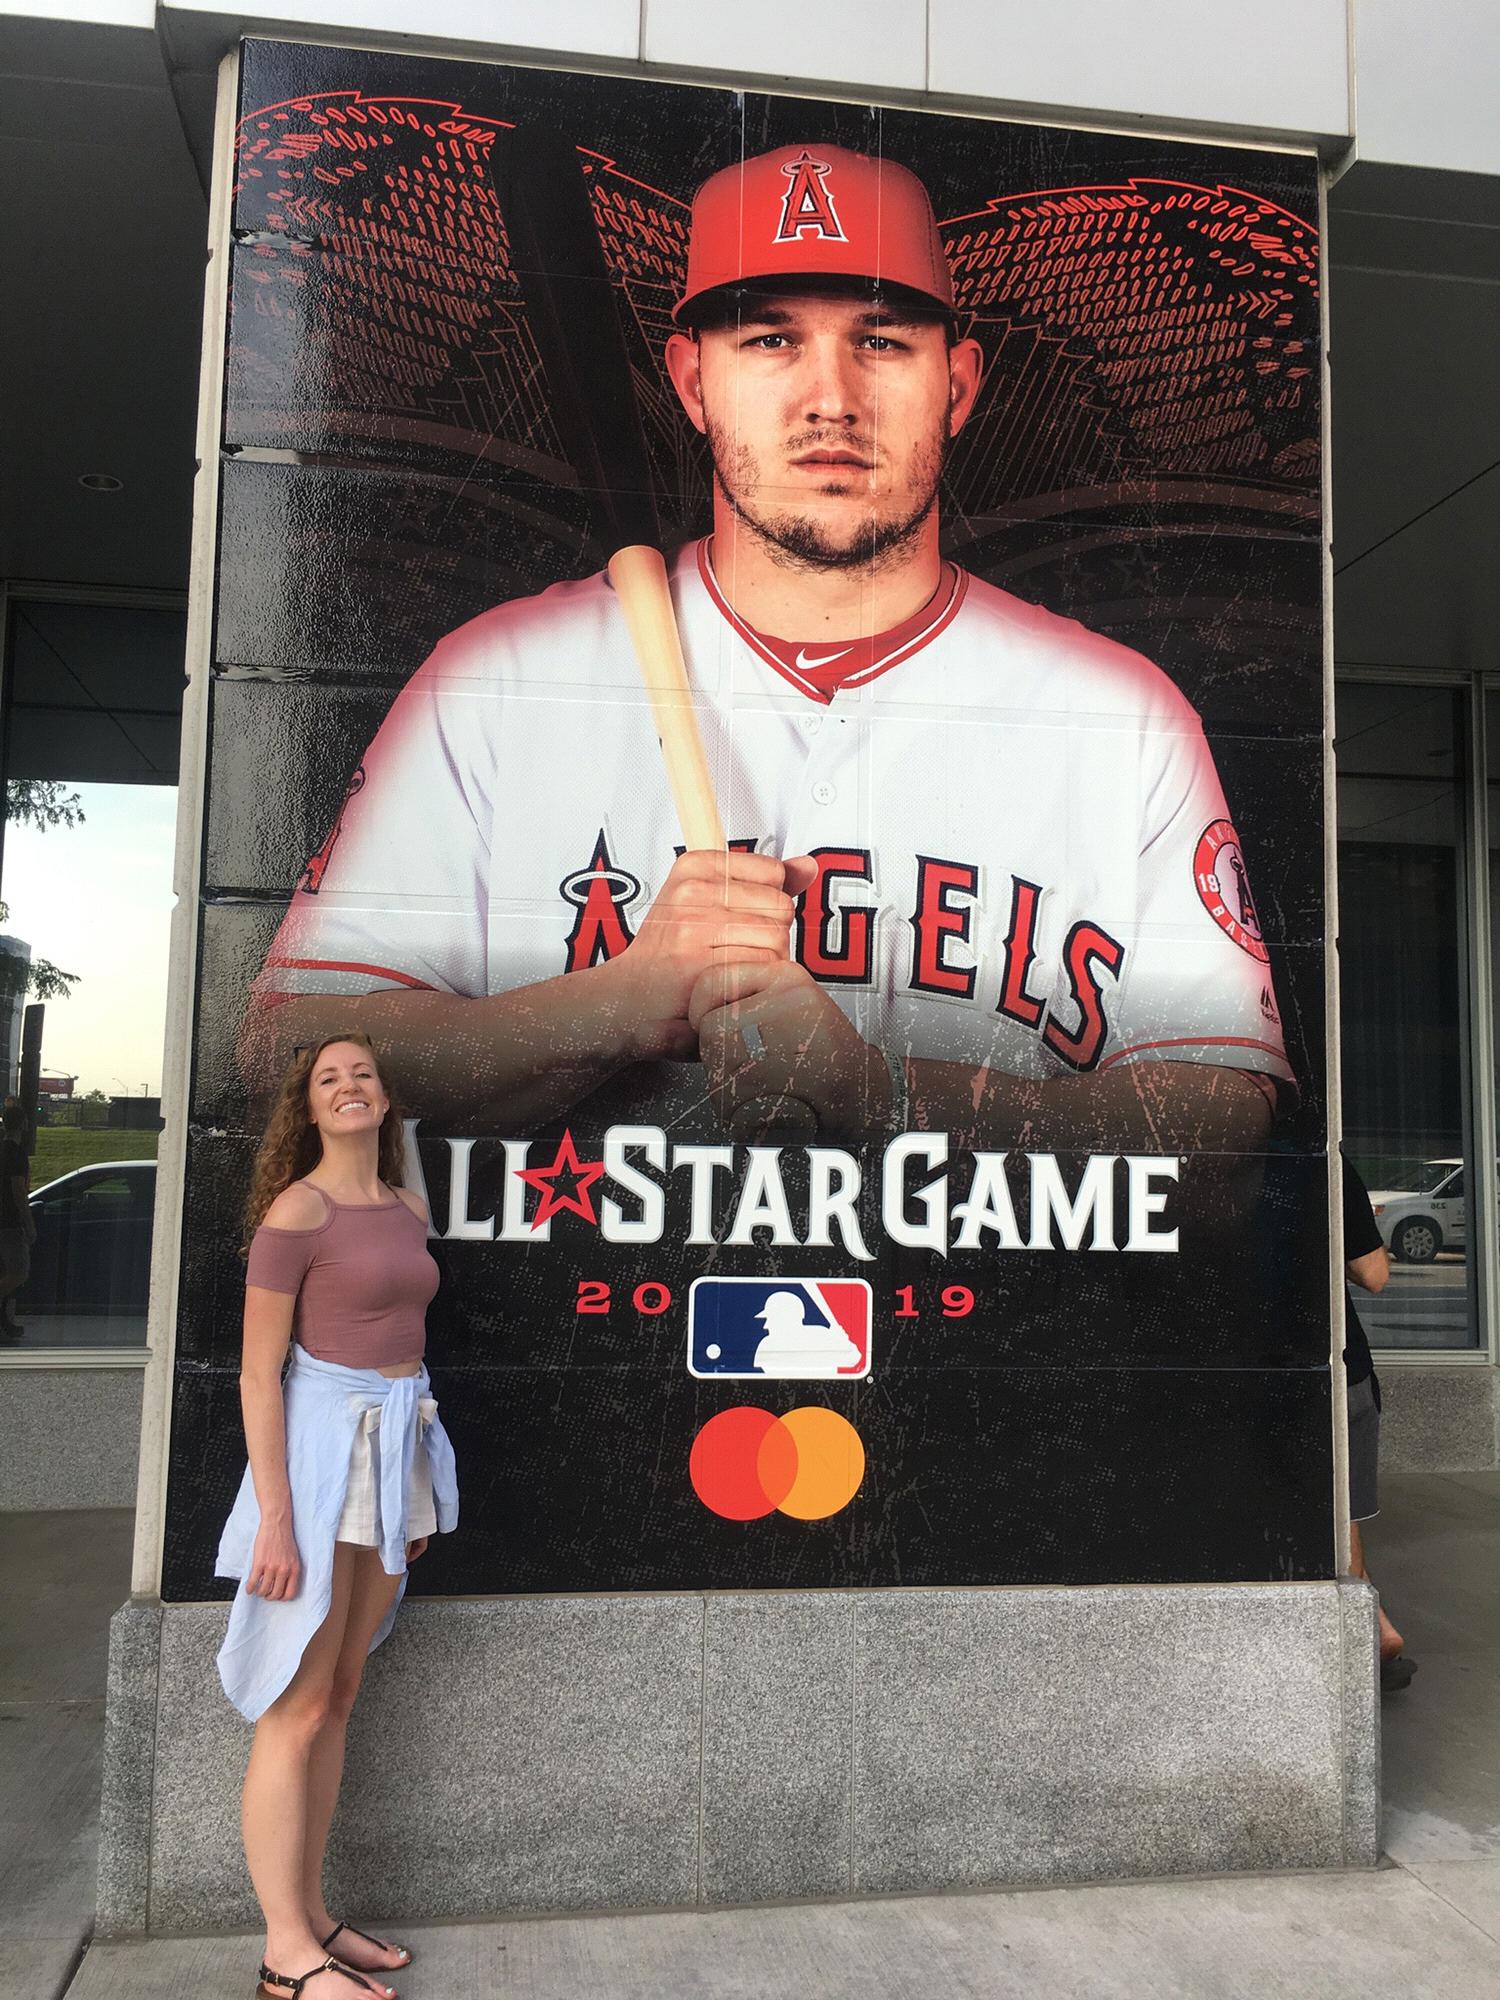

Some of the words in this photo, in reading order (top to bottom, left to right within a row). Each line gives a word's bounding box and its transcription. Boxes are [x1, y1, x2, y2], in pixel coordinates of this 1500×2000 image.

[772, 151, 849, 243] A
[560, 828, 1125, 1073] AGELS
[601, 1124, 876, 1261] STAR
[882, 1131, 1179, 1259] GAME
[576, 1281, 672, 1315] 20
[894, 1285, 975, 1318] 19
